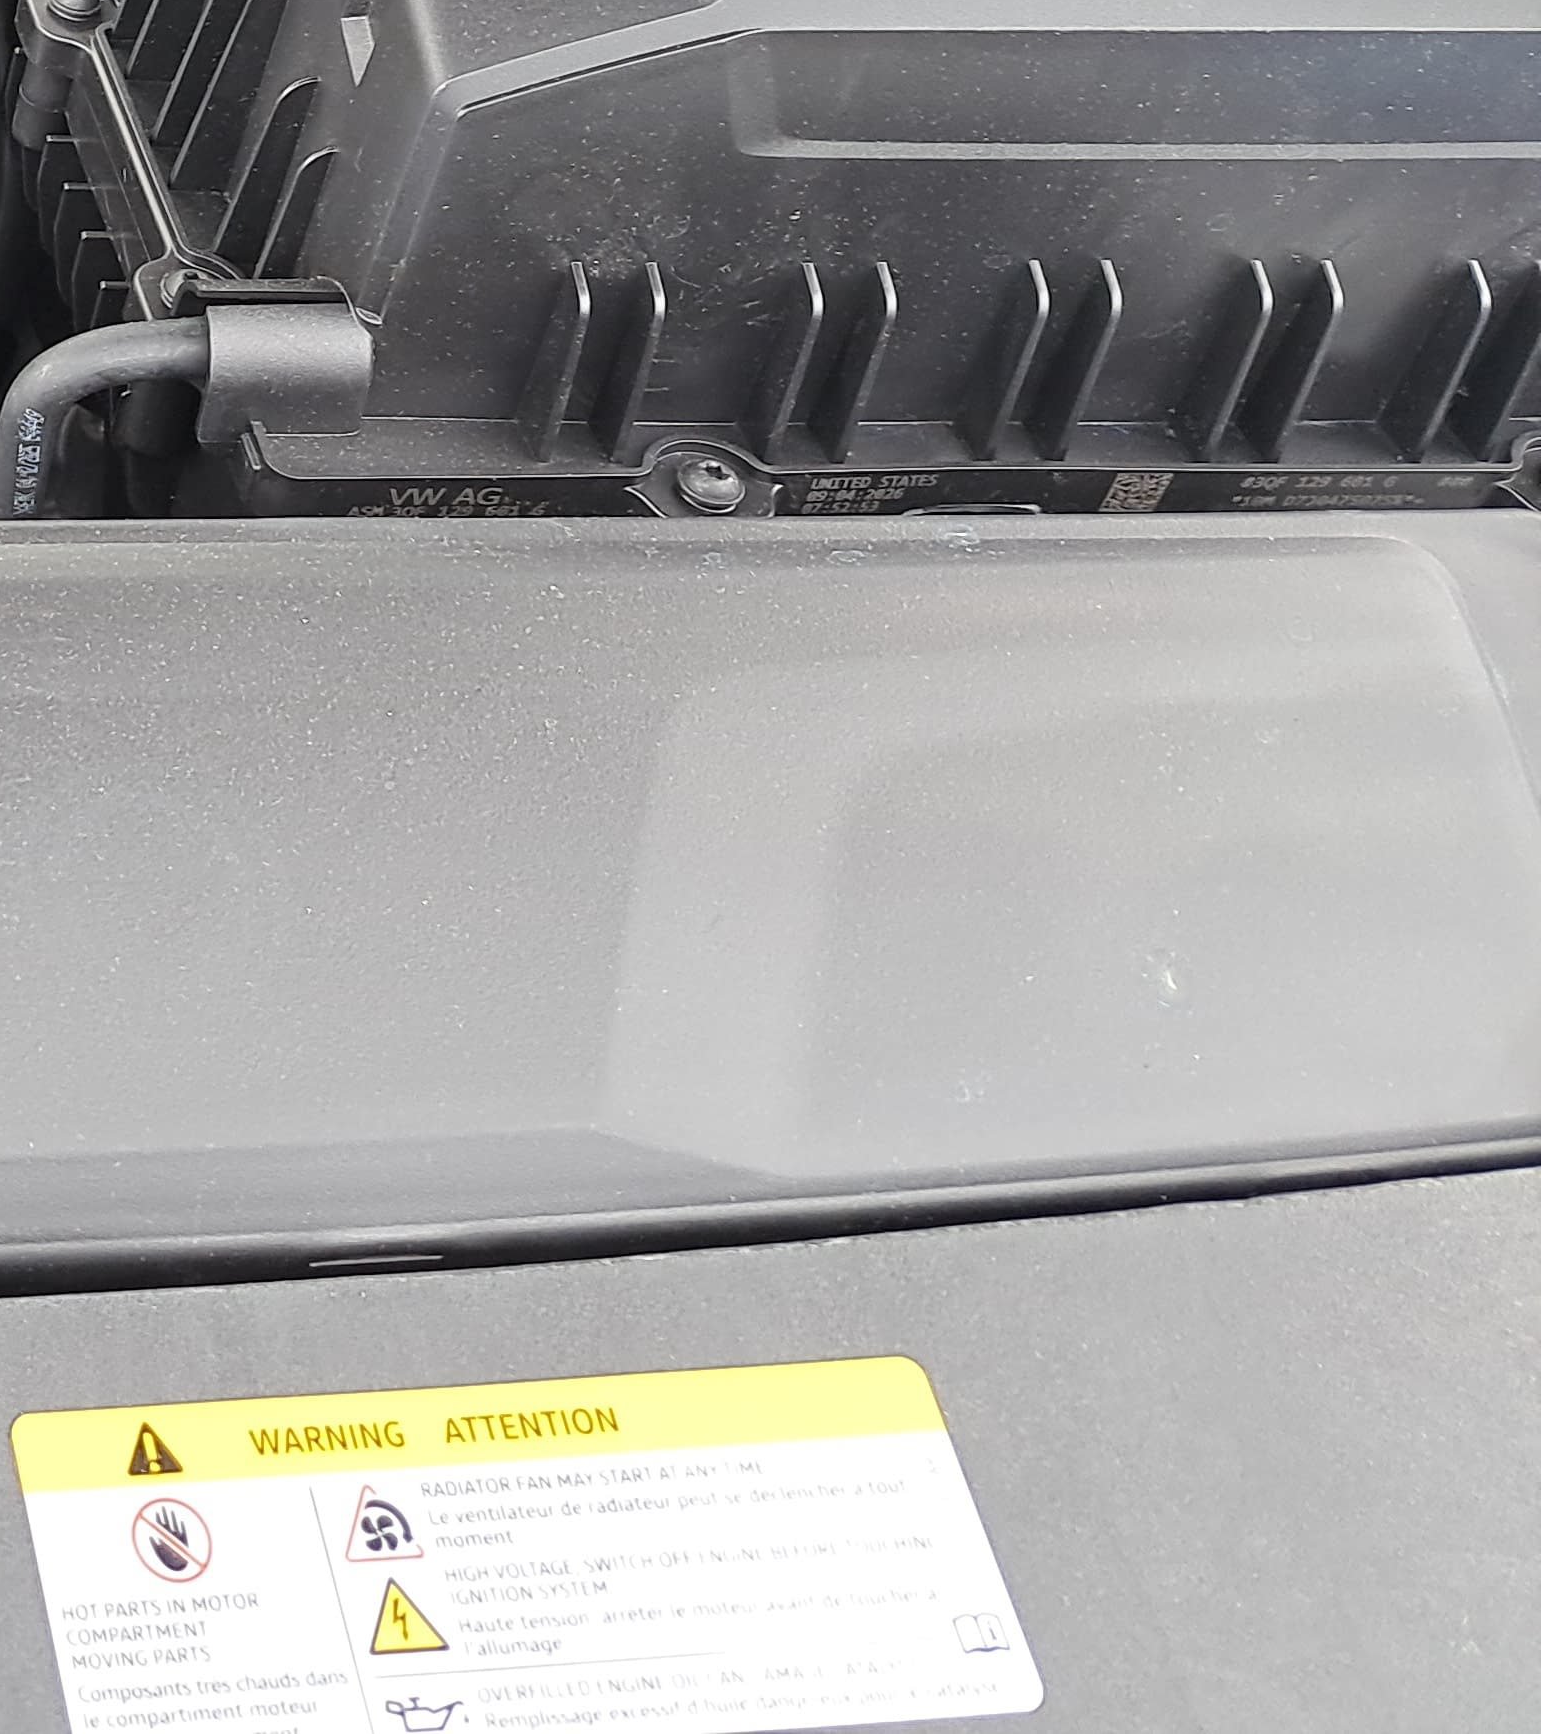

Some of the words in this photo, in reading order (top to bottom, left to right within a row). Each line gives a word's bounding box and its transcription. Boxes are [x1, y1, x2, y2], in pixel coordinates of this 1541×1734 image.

[811, 477, 872, 490] UNITED
[878, 474, 939, 488] STATES
[389, 487, 447, 506] VW
[452, 486, 504, 506] AG
[249, 1421, 406, 1456] WARNING
[445, 1406, 620, 1444] ATTENTION
[420, 1476, 512, 1498] RADIATOR
[516, 1474, 553, 1491] FAN
[557, 1471, 594, 1488] MAY
[598, 1466, 652, 1486] START
[427, 1509, 449, 1526] Le
[455, 1503, 554, 1524] ventilateur
[560, 1499, 582, 1516] de
[588, 1495, 670, 1515] radiateur
[435, 1529, 514, 1549] moment
[445, 1564, 489, 1582] HIGH
[61, 1602, 98, 1622] HOT
[103, 1598, 162, 1619] PARTS
[166, 1597, 187, 1614] IN
[191, 1591, 260, 1614] MOTOR
[450, 1585, 533, 1606] IGNITION
[65, 1619, 207, 1646] COMPARTMENT
[458, 1616, 515, 1633] Haute
[71, 1649, 148, 1671] MOVING
[153, 1645, 212, 1666] PARTS
[78, 1681, 191, 1704] Composants
[236, 1672, 300, 1693] chauds
[305, 1669, 348, 1687] dans
[83, 1712, 100, 1729] le
[106, 1701, 245, 1729] compartiment
[249, 1700, 318, 1719] moteur
